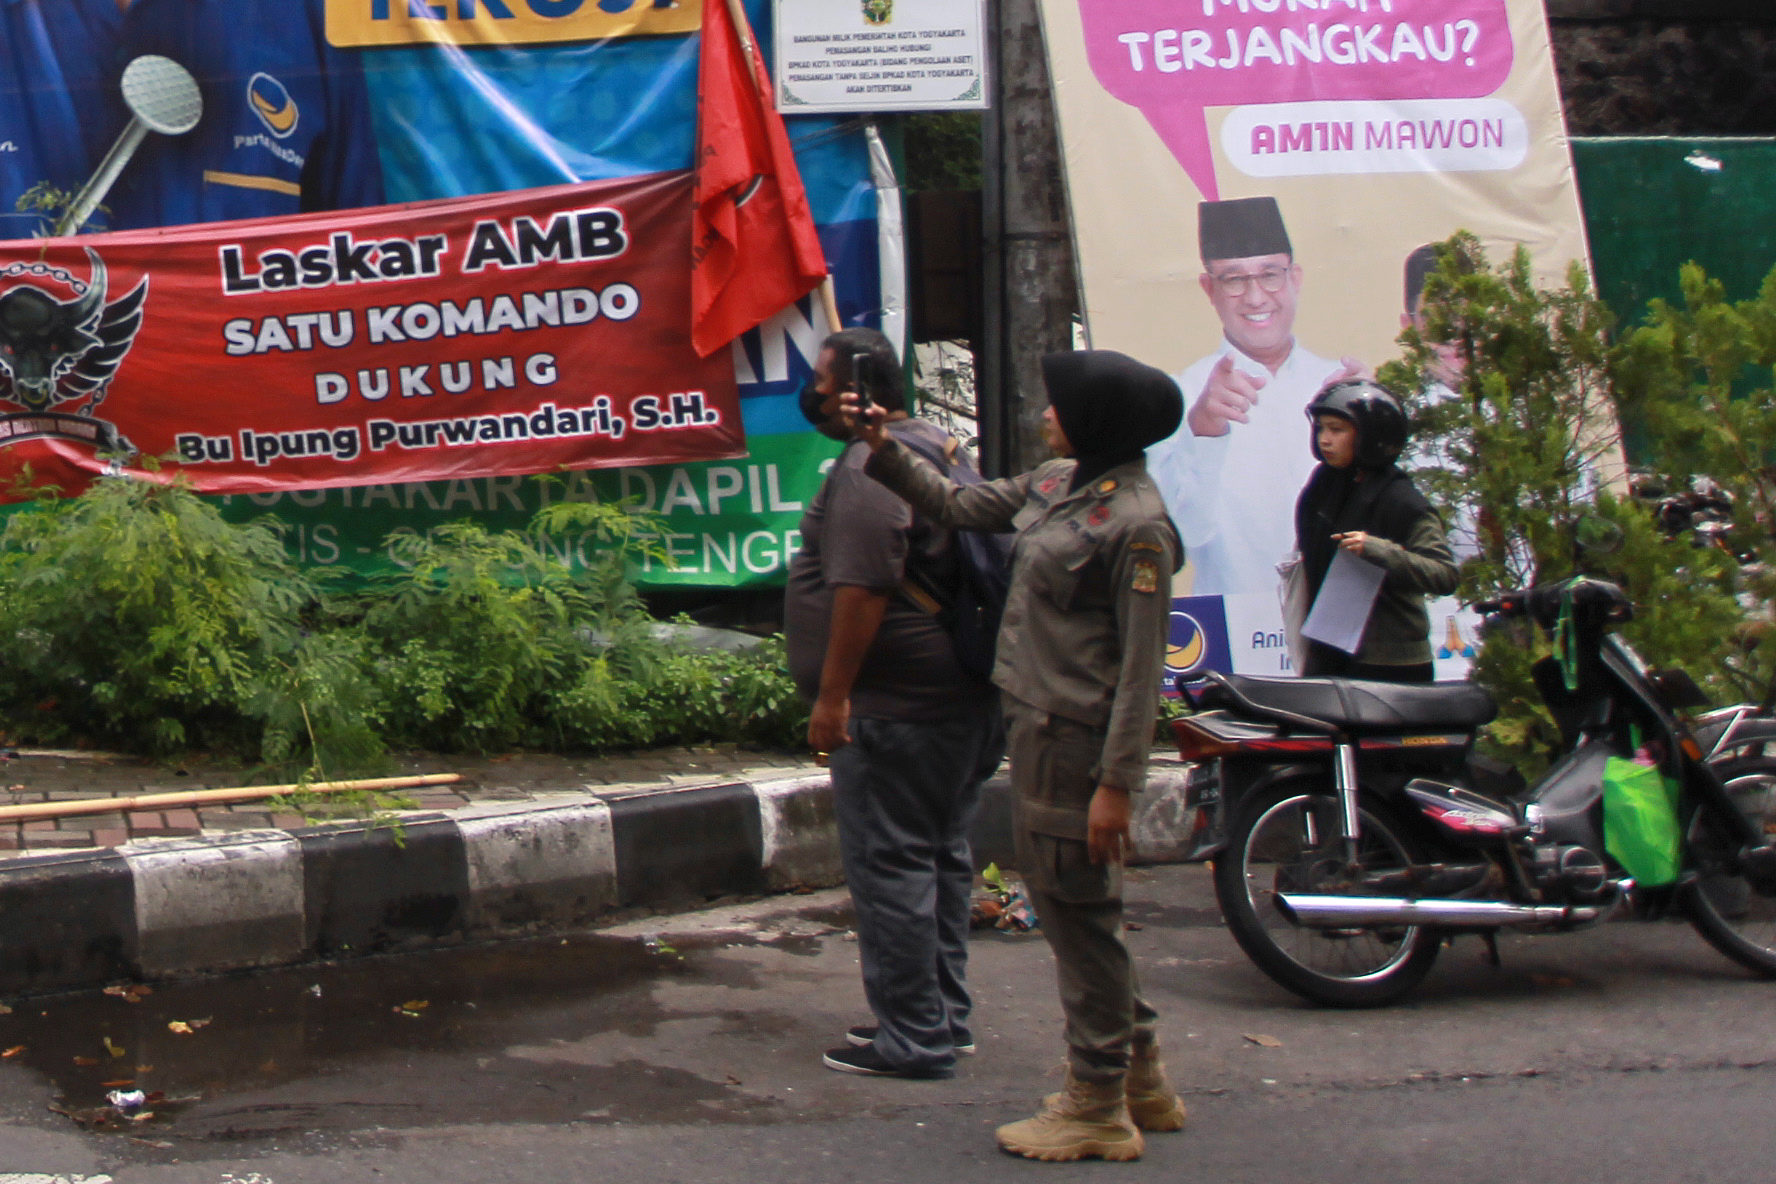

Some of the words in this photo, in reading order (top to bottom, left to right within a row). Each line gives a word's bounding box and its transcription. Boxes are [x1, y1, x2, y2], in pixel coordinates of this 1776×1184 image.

[898, 31, 917, 40] KOTA
[919, 29, 966, 39] YOGYAKARTA
[1117, 17, 1480, 74] TERJANGKAU?
[812, 59, 830, 68] KOTA
[1365, 118, 1504, 151] MAWON
[221, 231, 445, 295] Laskar
[462, 209, 628, 274] AMB
[224, 309, 355, 356] SATU
[367, 283, 640, 344] KOMANDO
[176, 432, 232, 464] Bu
[243, 424, 359, 468] Ipung
[369, 398, 625, 451] Purwandari,
[631, 391, 719, 431] S.H.
[619, 463, 803, 516] DAPIL
[1252, 630, 1287, 650] Ani
